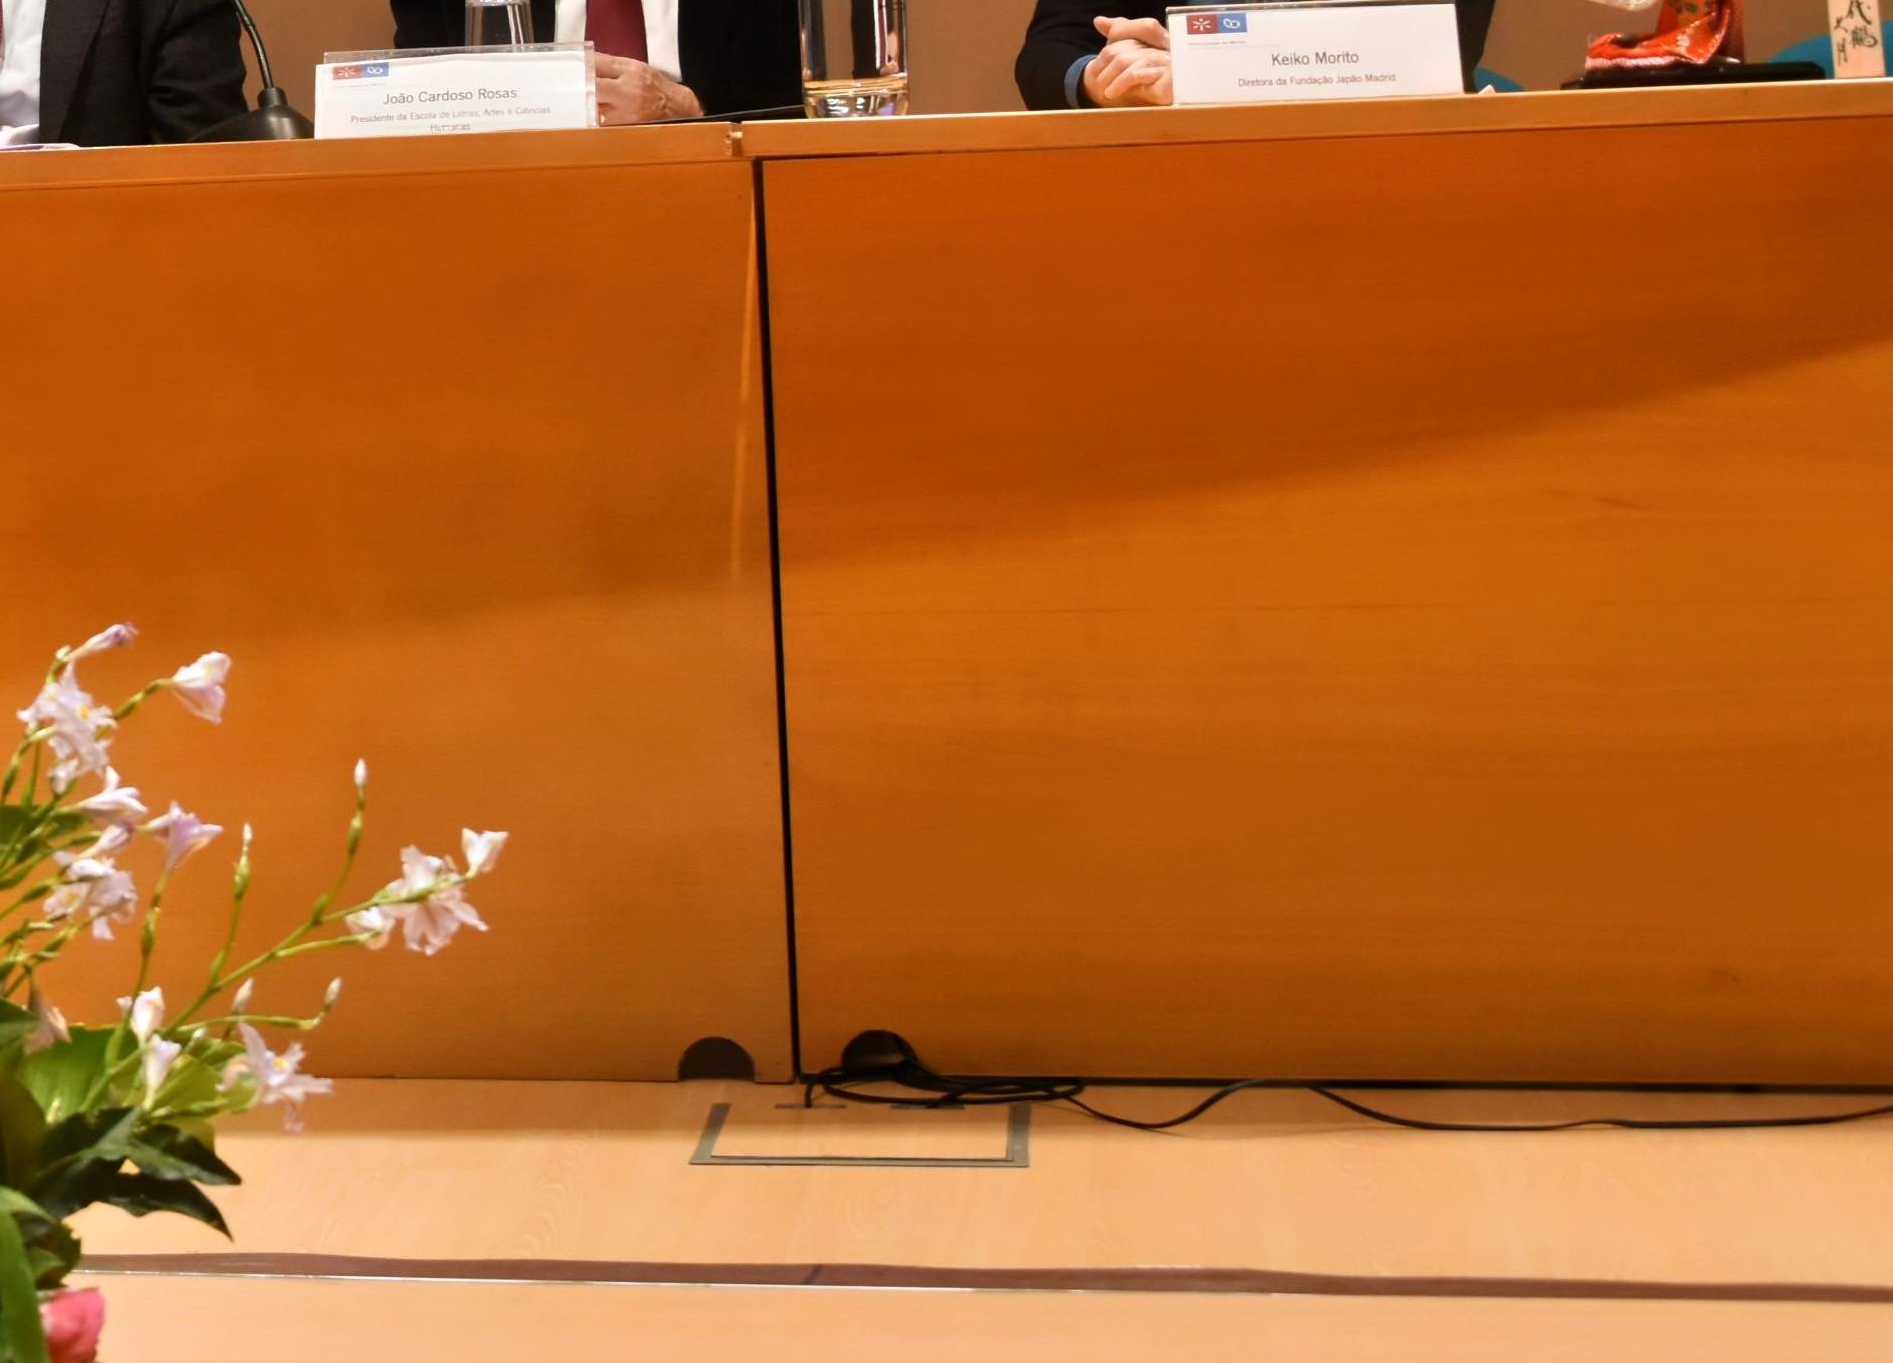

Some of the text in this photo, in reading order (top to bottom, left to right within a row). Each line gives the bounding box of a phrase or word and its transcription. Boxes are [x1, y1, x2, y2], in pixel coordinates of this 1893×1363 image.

[1271, 50, 1359, 66] Keiko Morito
[1238, 73, 1396, 87] Diretora da Fundação Japão Madrid
[383, 88, 517, 105] João Cardoso Rosas
[351, 113, 395, 123] Presidente
[397, 112, 407, 121] da
[410, 111, 437, 120] Escola
[439, 110, 450, 119] de
[483, 107, 504, 116] Artes
[515, 105, 551, 114] Ciências
